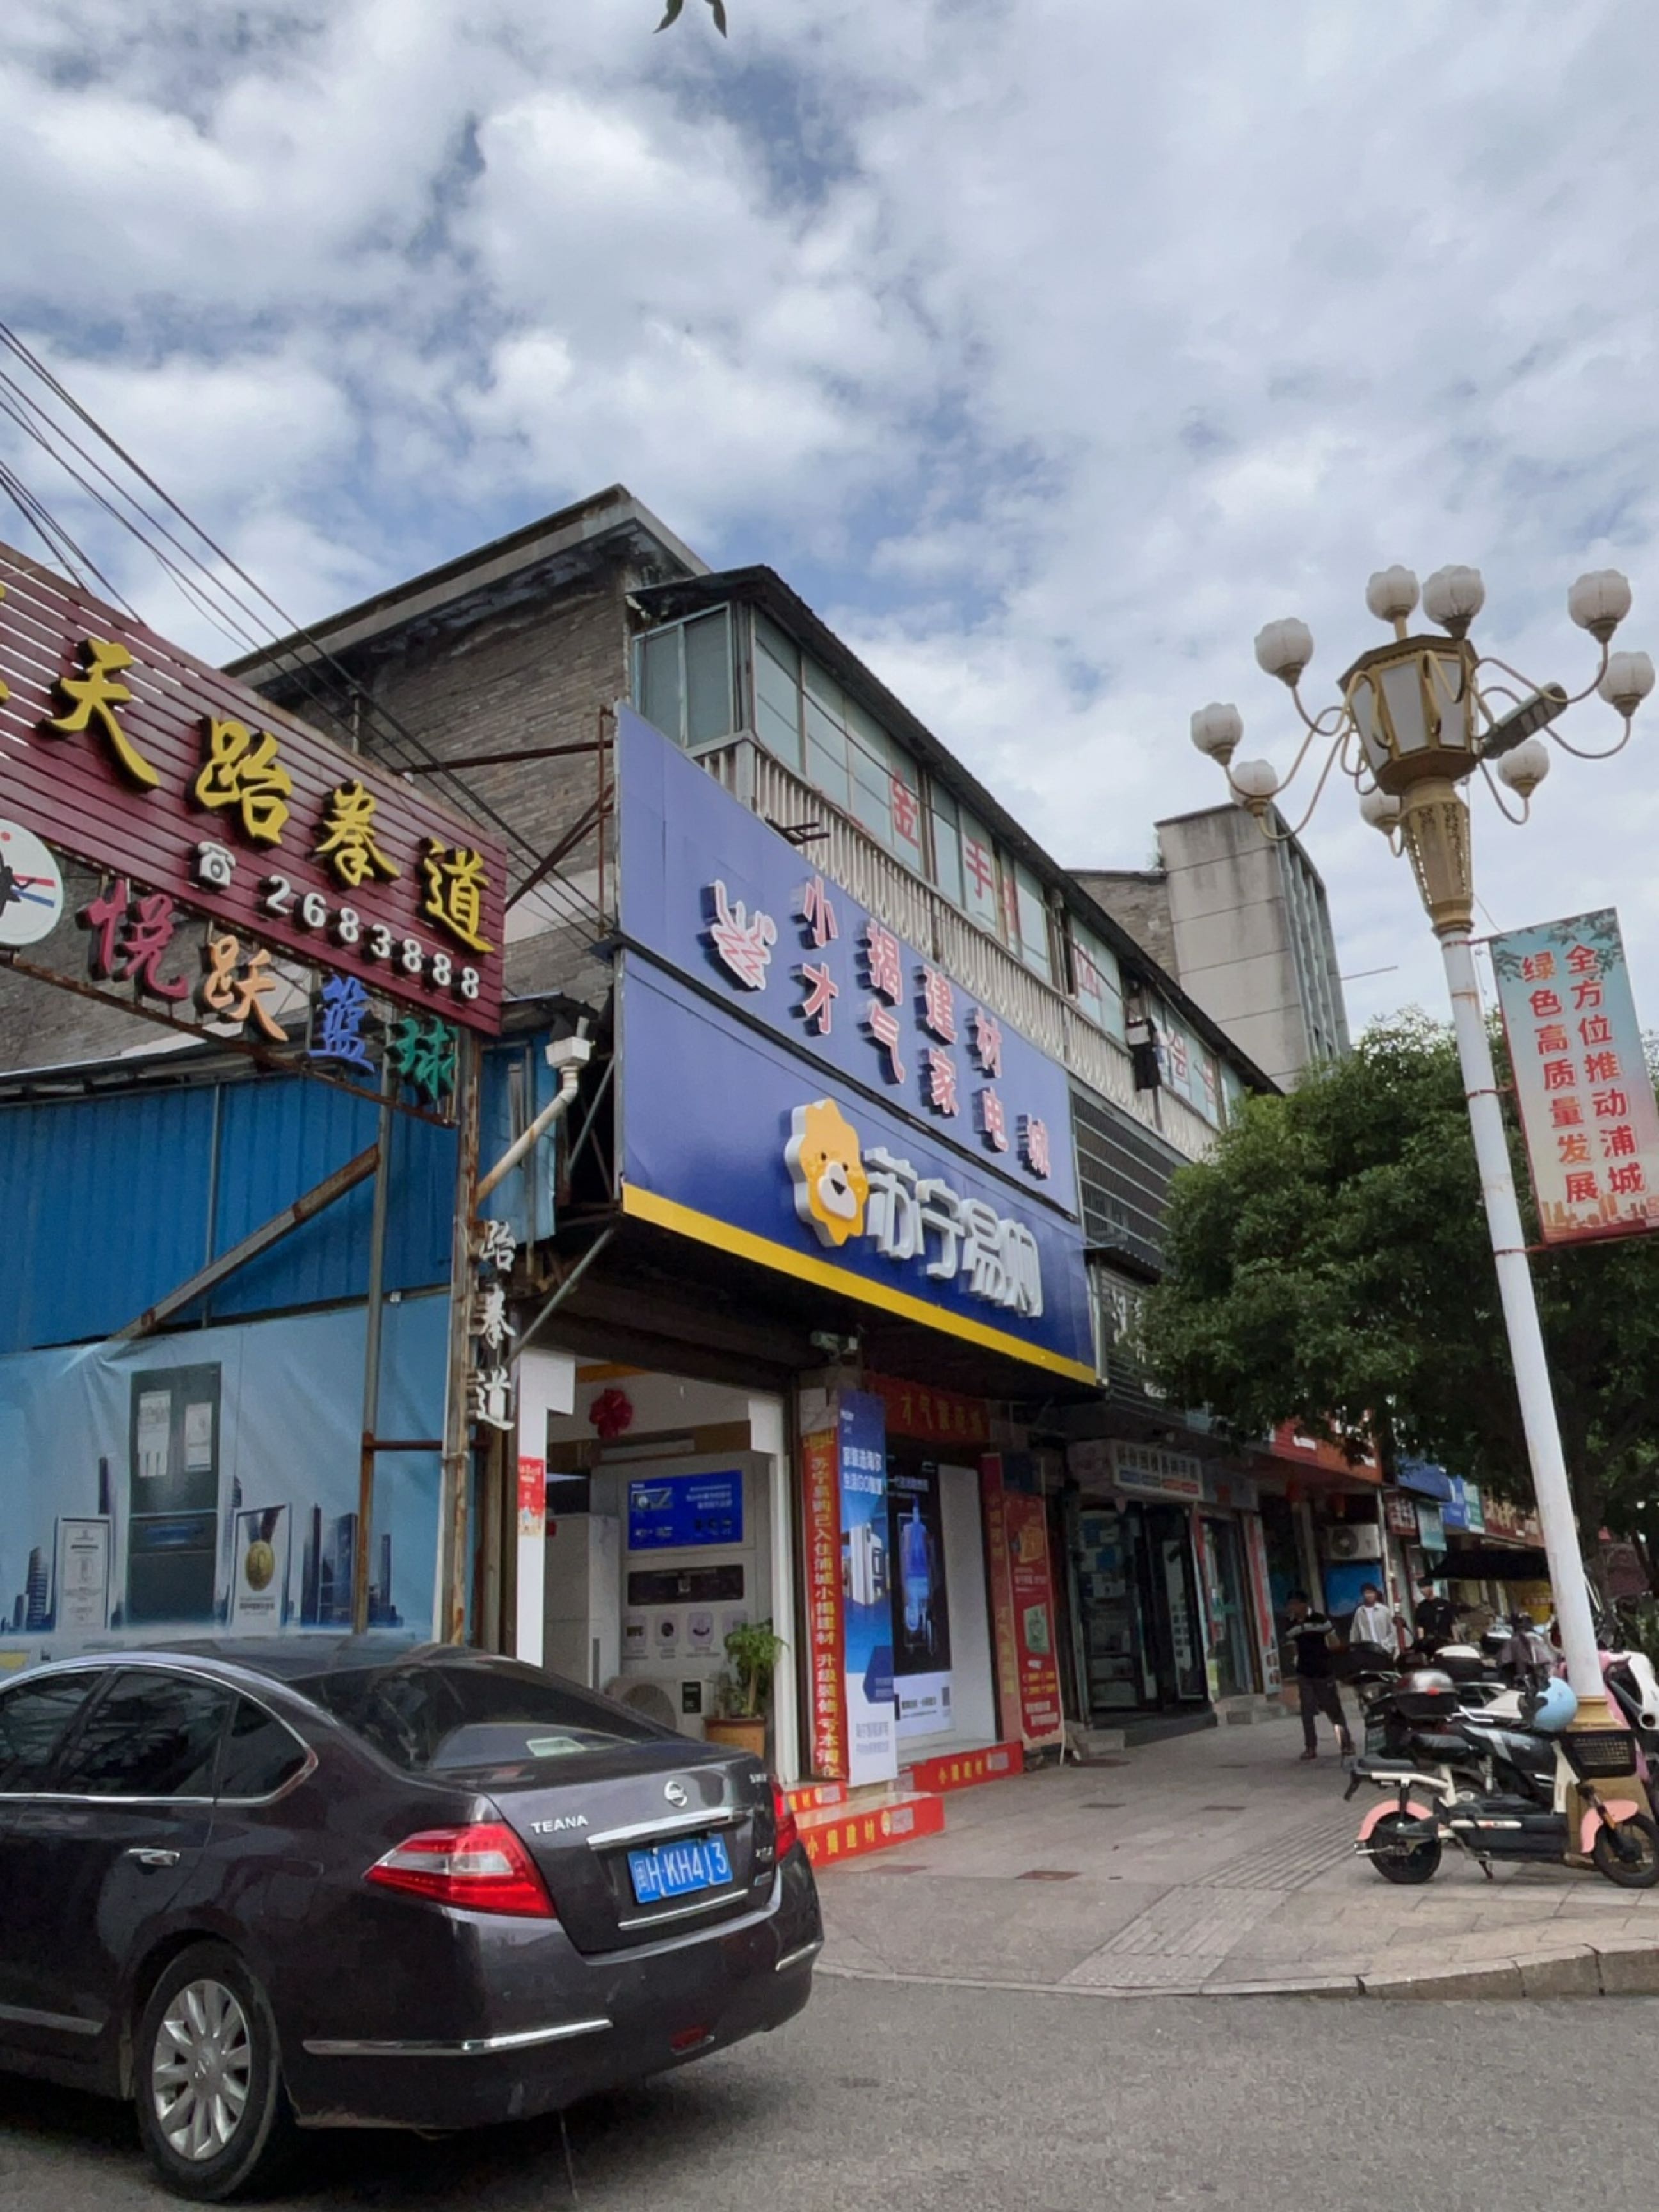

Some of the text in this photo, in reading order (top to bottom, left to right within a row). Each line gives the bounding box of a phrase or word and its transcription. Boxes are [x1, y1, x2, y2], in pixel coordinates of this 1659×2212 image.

[261, 874, 479, 1000] 2683888
[1522, 951, 1598, 1204] 绿色高质量发展
[1564, 943, 1646, 1196] 全方位推动浦城
[476, 1219, 515, 1431] 跆拳道
[864, 1146, 1043, 1318] 苏宁易购
[530, 1815, 589, 1835] TEANA
